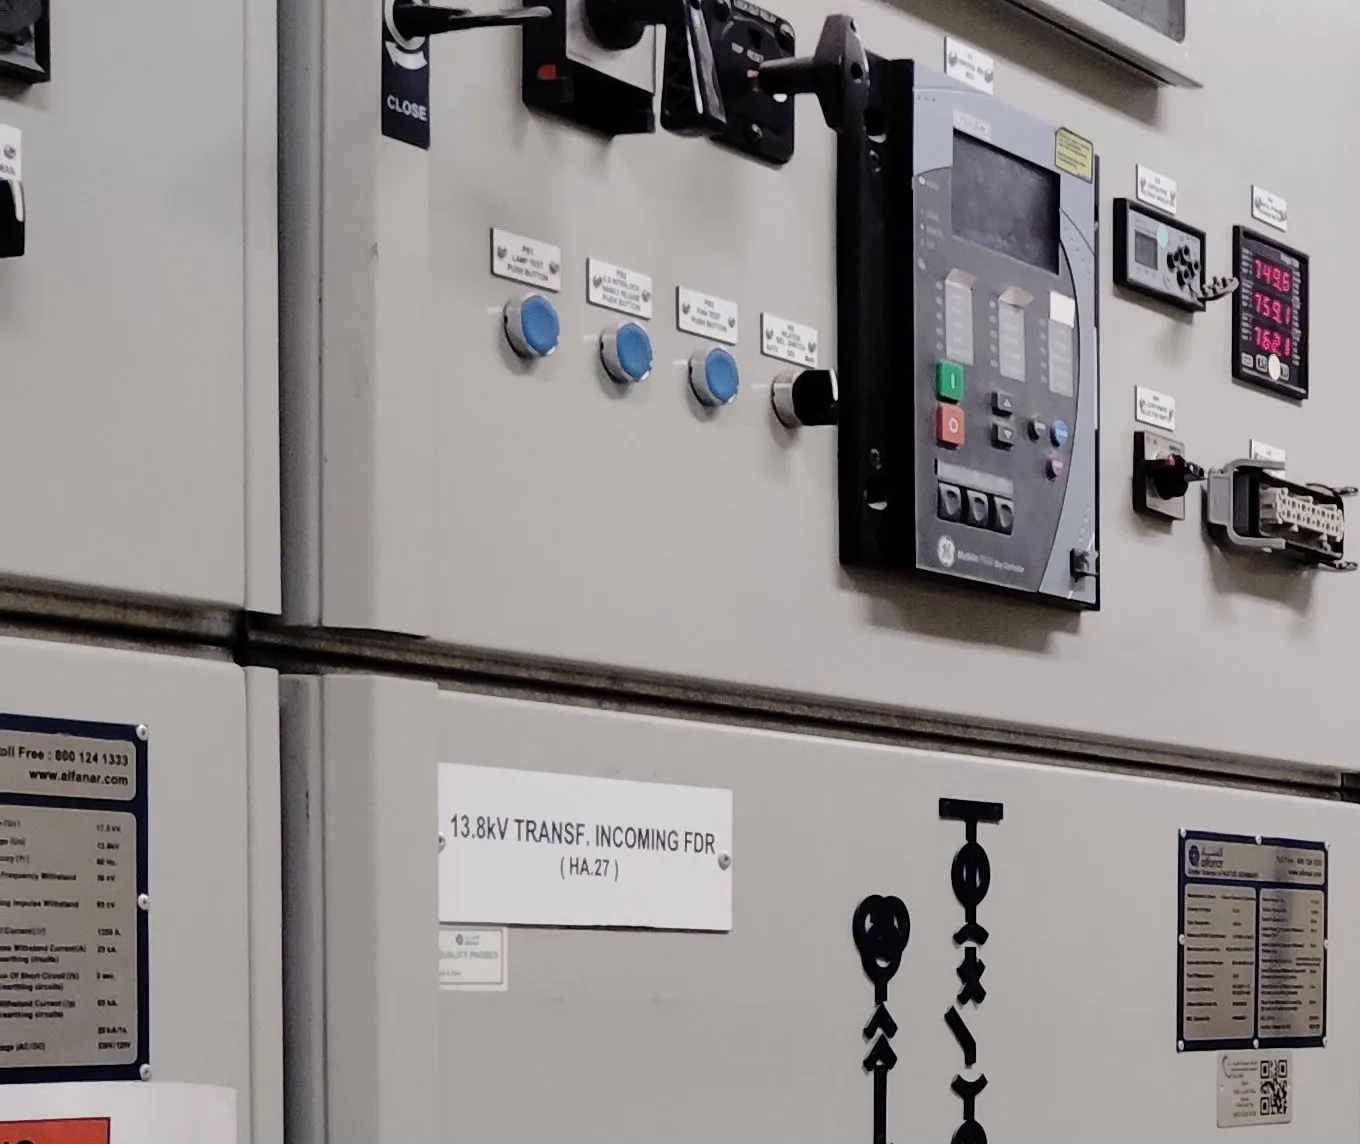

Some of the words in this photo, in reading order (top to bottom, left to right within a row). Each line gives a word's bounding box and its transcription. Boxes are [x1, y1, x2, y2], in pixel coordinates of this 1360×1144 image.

[386, 94, 428, 122] CLOSE
[0, 746, 15, 758] oll
[18, 747, 45, 761] Free
[79, 751, 99, 765] 124
[102, 753, 129, 767] 1333
[29, 770, 129, 786] www.alfanar.com
[450, 813, 510, 841] 13.8kV
[513, 818, 590, 848] TRANSF.
[595, 824, 679, 852] INCOMING
[684, 830, 716, 855] FDR
[569, 857, 610, 878] HA.27
